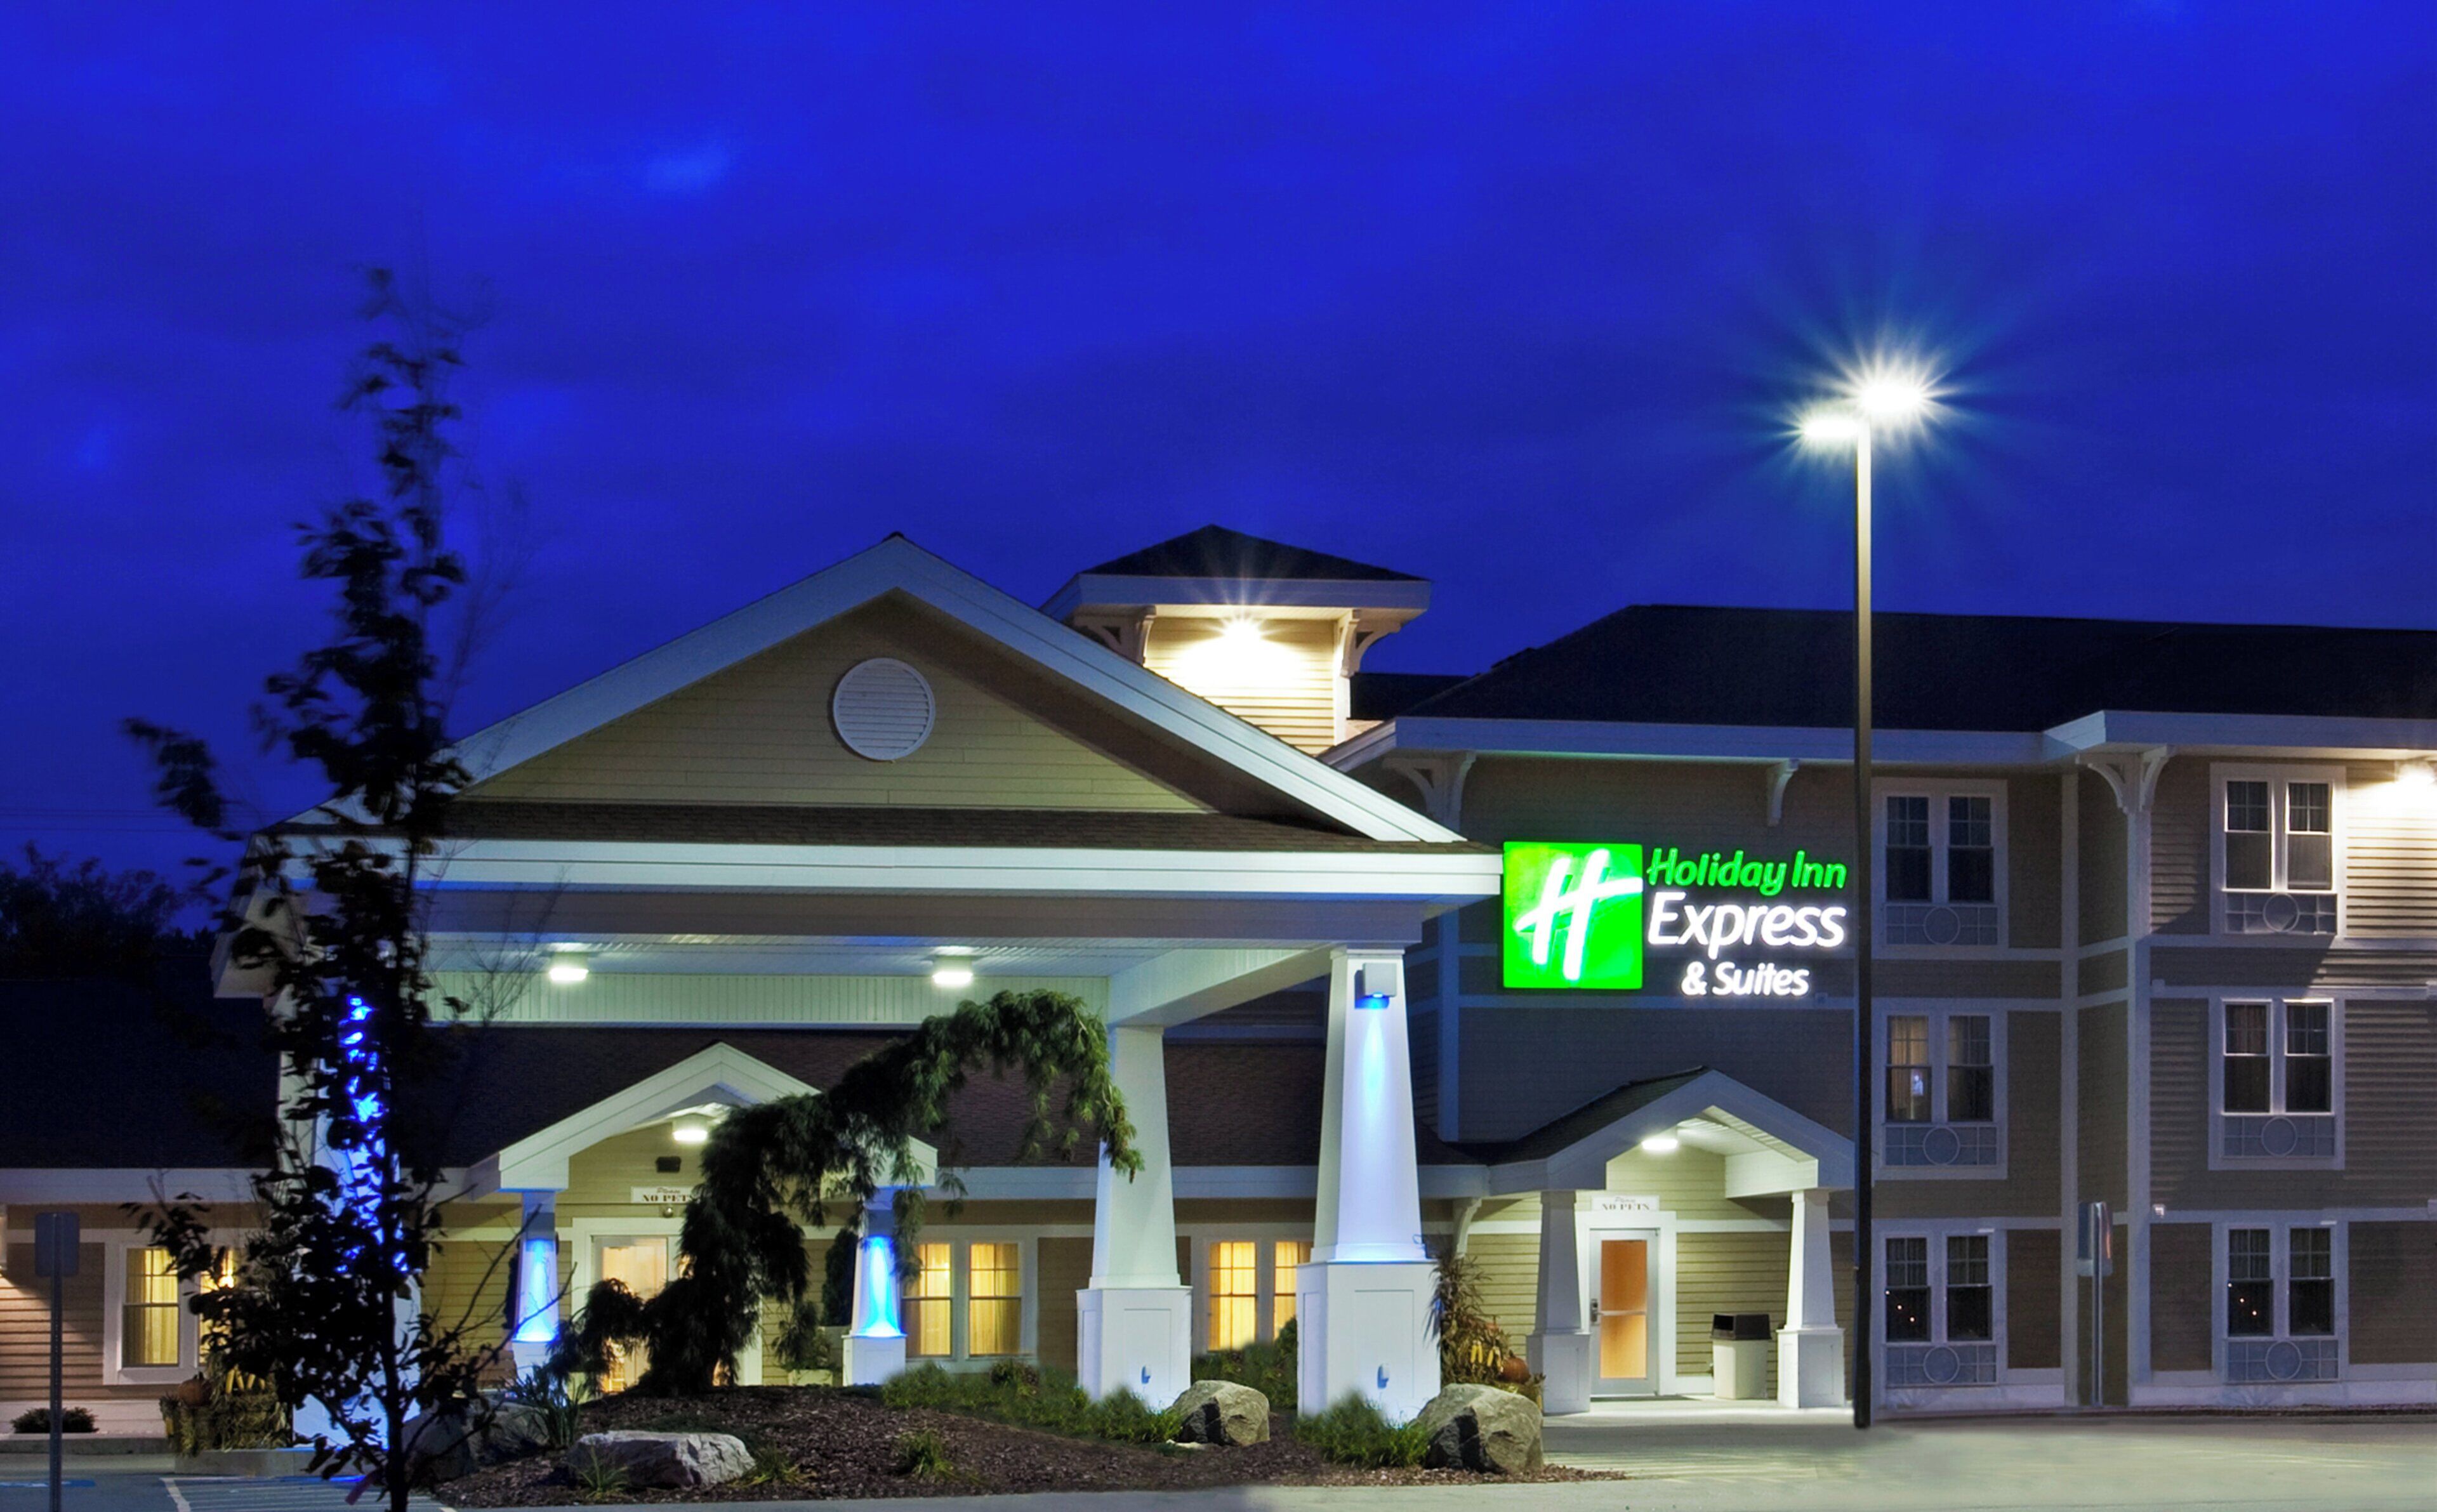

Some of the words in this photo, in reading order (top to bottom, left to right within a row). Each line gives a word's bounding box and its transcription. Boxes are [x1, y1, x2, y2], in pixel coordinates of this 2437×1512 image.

[1647, 847, 1785, 895] Holiday
[1792, 851, 1847, 889] Inn
[1648, 891, 1847, 960] Express
[1681, 962, 1707, 996] &
[1712, 962, 1810, 996] Suites
